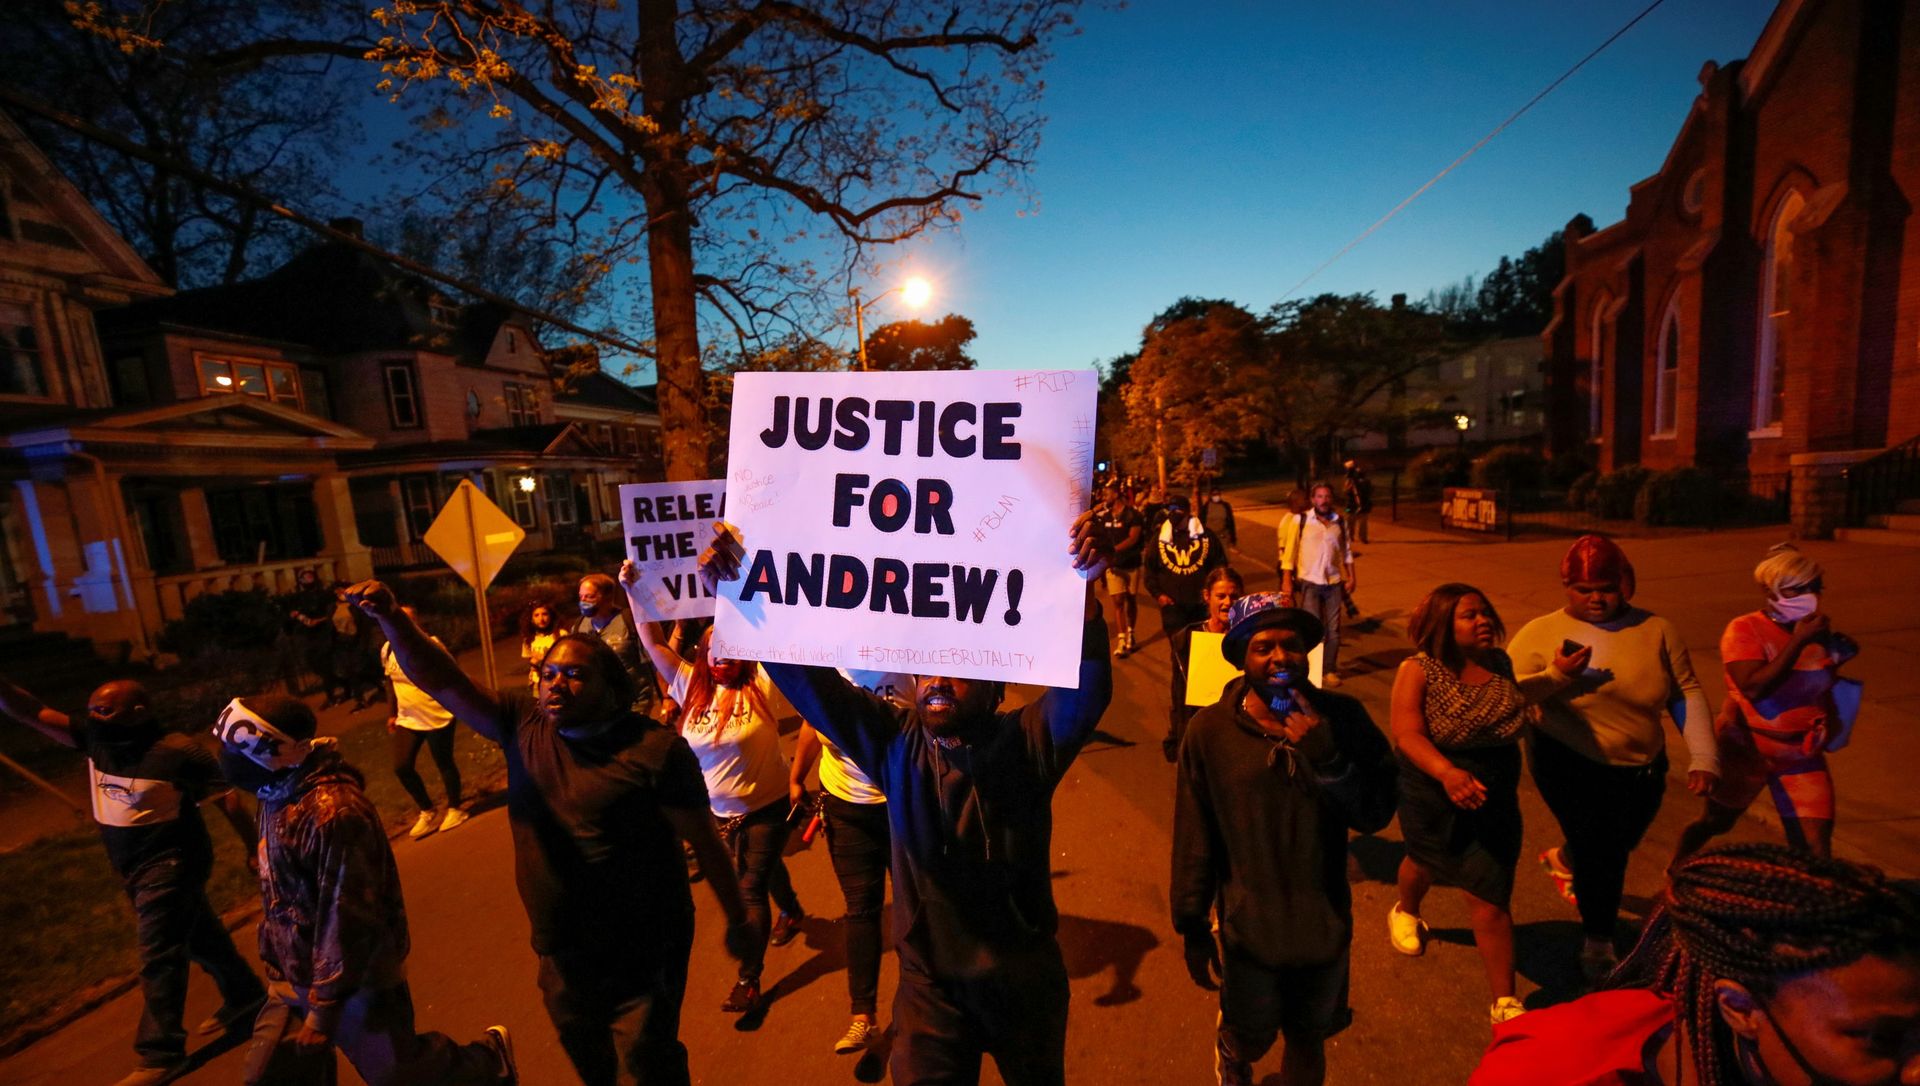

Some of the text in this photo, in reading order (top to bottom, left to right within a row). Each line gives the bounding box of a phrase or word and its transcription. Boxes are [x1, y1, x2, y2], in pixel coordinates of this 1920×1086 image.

[1013, 370, 1076, 393] #RIP
[759, 395, 1022, 461] JUSTICE
[832, 473, 955, 535] FOR
[972, 494, 1021, 543] #BLM
[630, 531, 698, 562] THE
[738, 549, 1024, 627] ANDREW!
[857, 645, 1035, 672] #STOPPOLICEBRUTALITY
